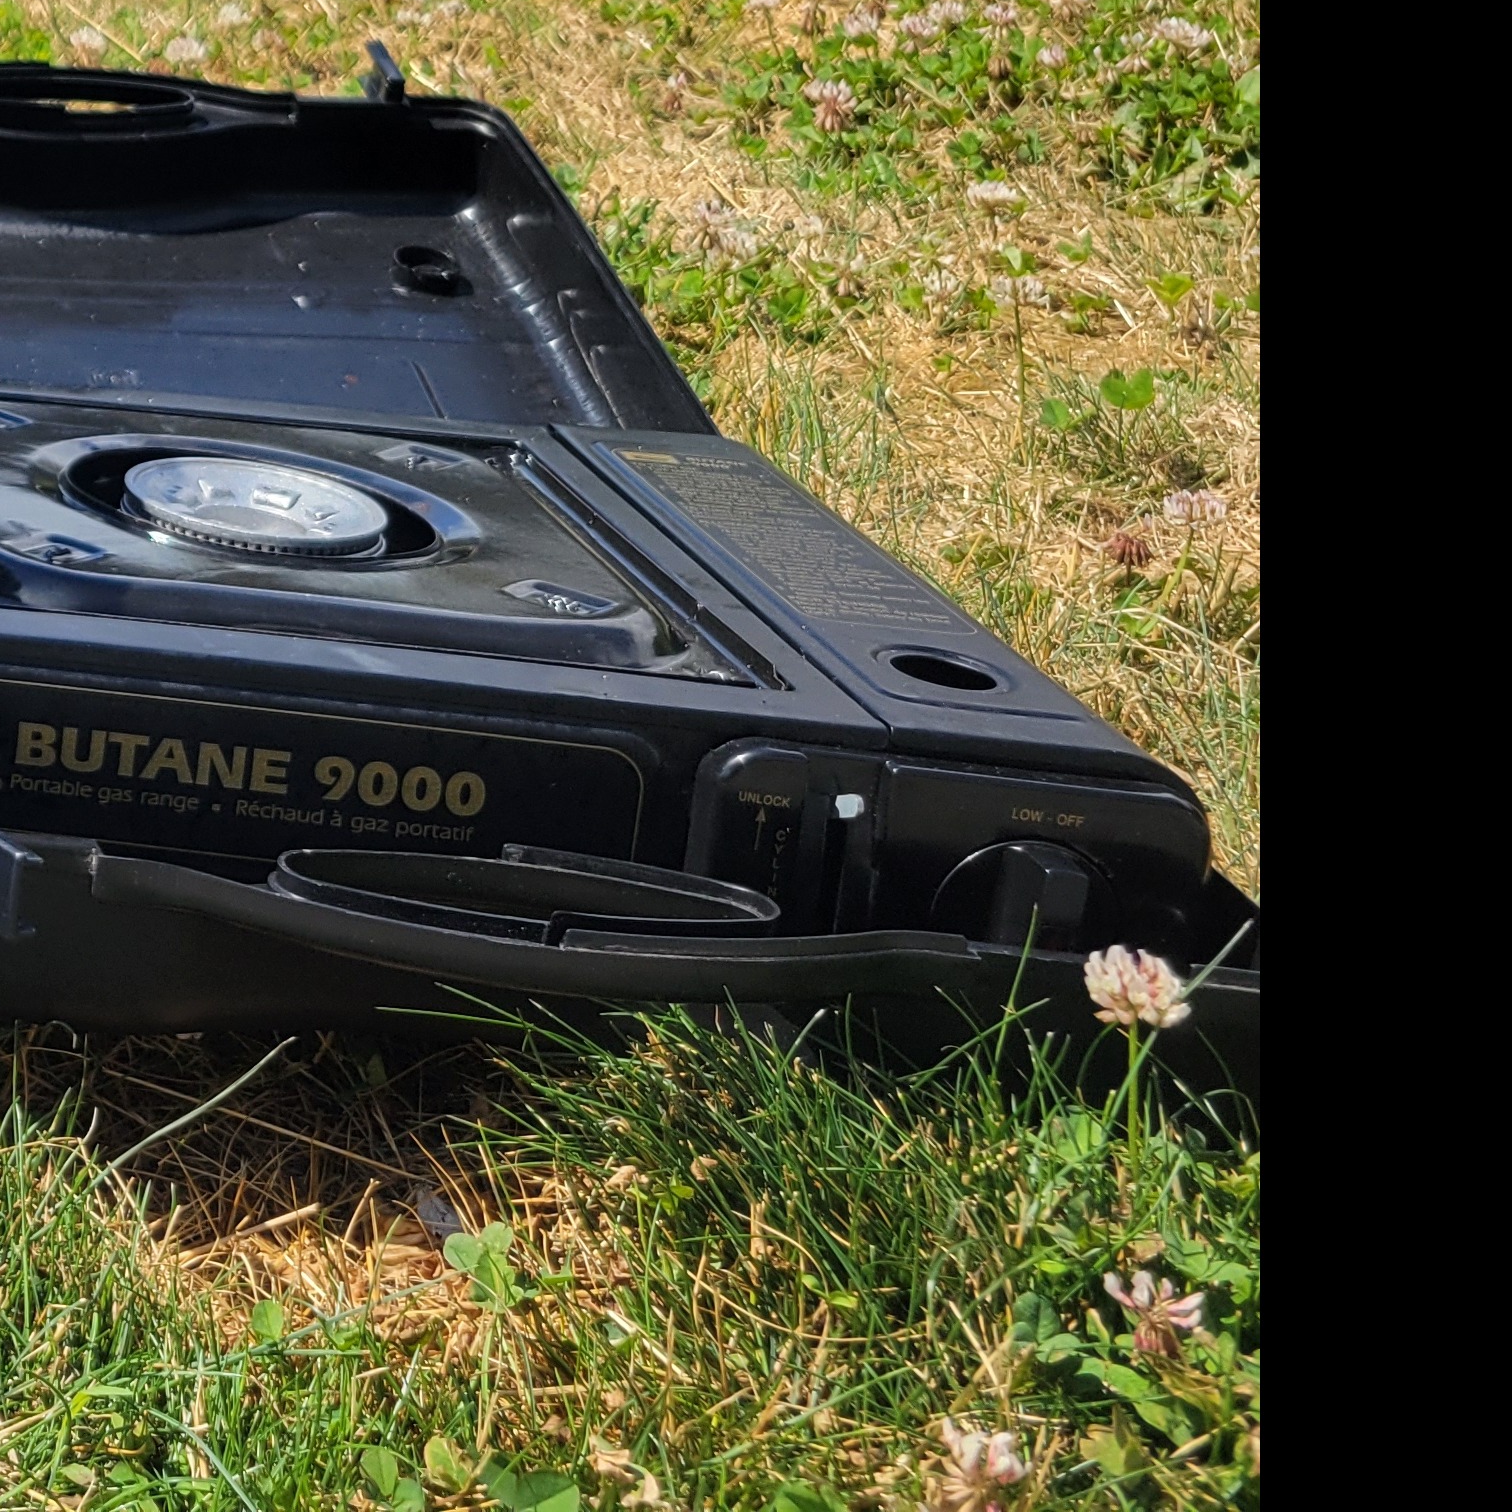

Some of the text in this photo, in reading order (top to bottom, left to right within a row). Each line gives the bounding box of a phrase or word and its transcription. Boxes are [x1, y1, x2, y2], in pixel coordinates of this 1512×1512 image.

[16, 721, 487, 817] BUTANE 9000
[10, 776, 200, 813] Portable gas range
[738, 790, 792, 808] UNLOCK
[235, 799, 474, 842] Réchaud à gaz portatif
[1011, 808, 1044, 822] LOW
[1057, 814, 1085, 828] OFF
